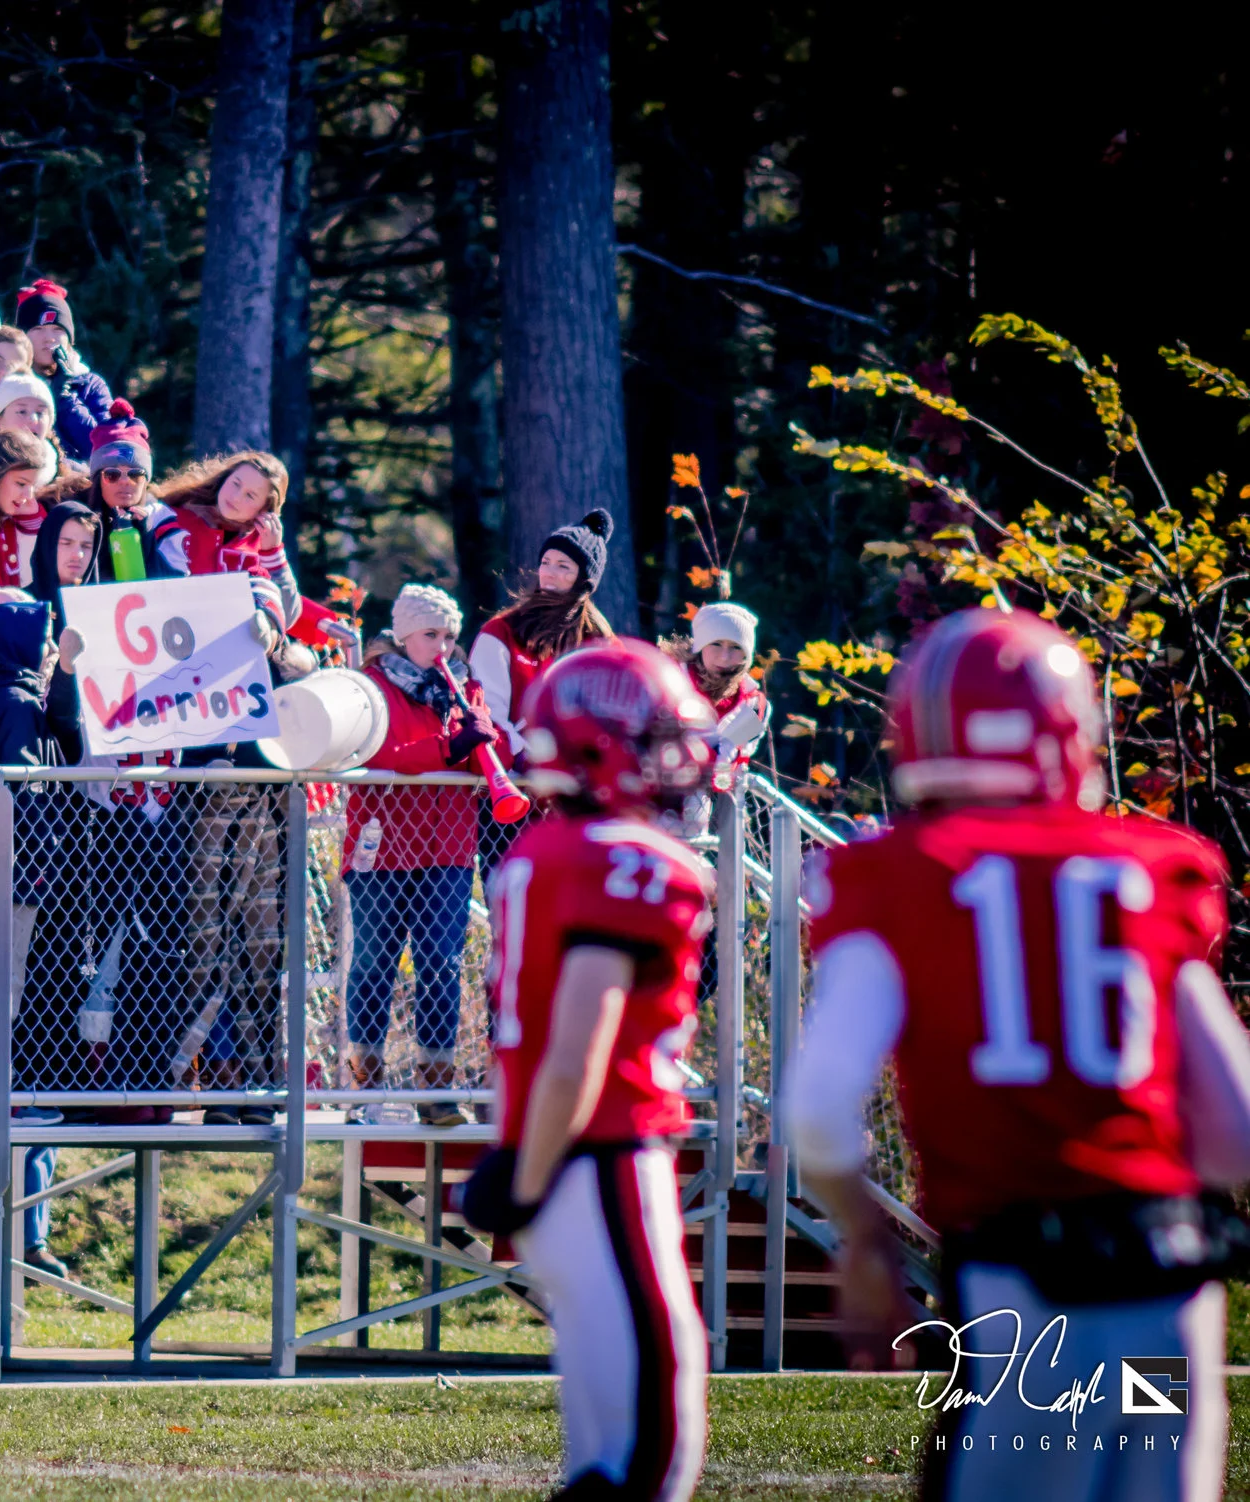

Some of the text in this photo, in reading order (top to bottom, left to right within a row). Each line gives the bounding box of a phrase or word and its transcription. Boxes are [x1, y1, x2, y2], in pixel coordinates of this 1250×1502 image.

[114, 593, 196, 666] Go
[82, 671, 270, 731] Warriors
[953, 854, 1156, 1090] 16
